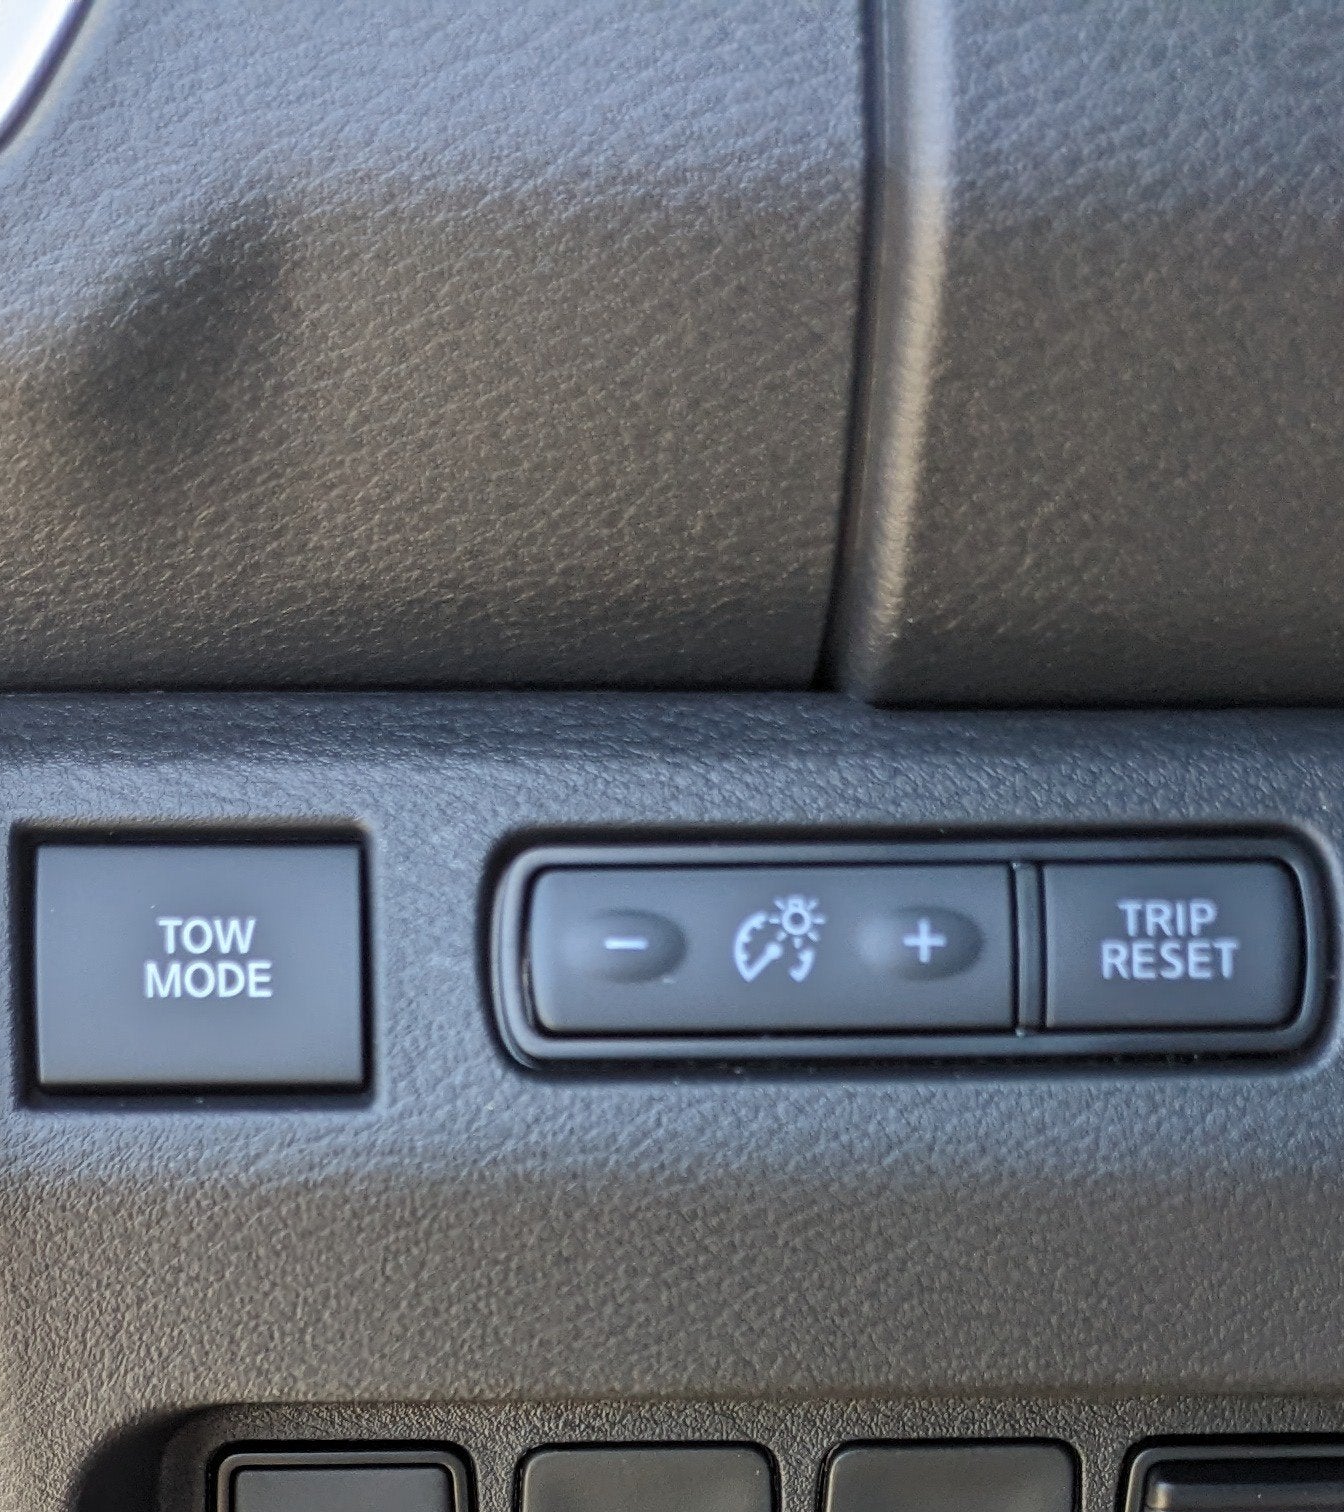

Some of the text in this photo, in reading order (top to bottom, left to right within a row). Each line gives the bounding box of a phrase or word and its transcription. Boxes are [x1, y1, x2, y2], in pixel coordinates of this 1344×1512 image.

[156, 917, 256, 955] TOW
[1116, 899, 1219, 937] TRIP
[1101, 939, 1240, 980] RESET
[144, 960, 274, 999] MODE
